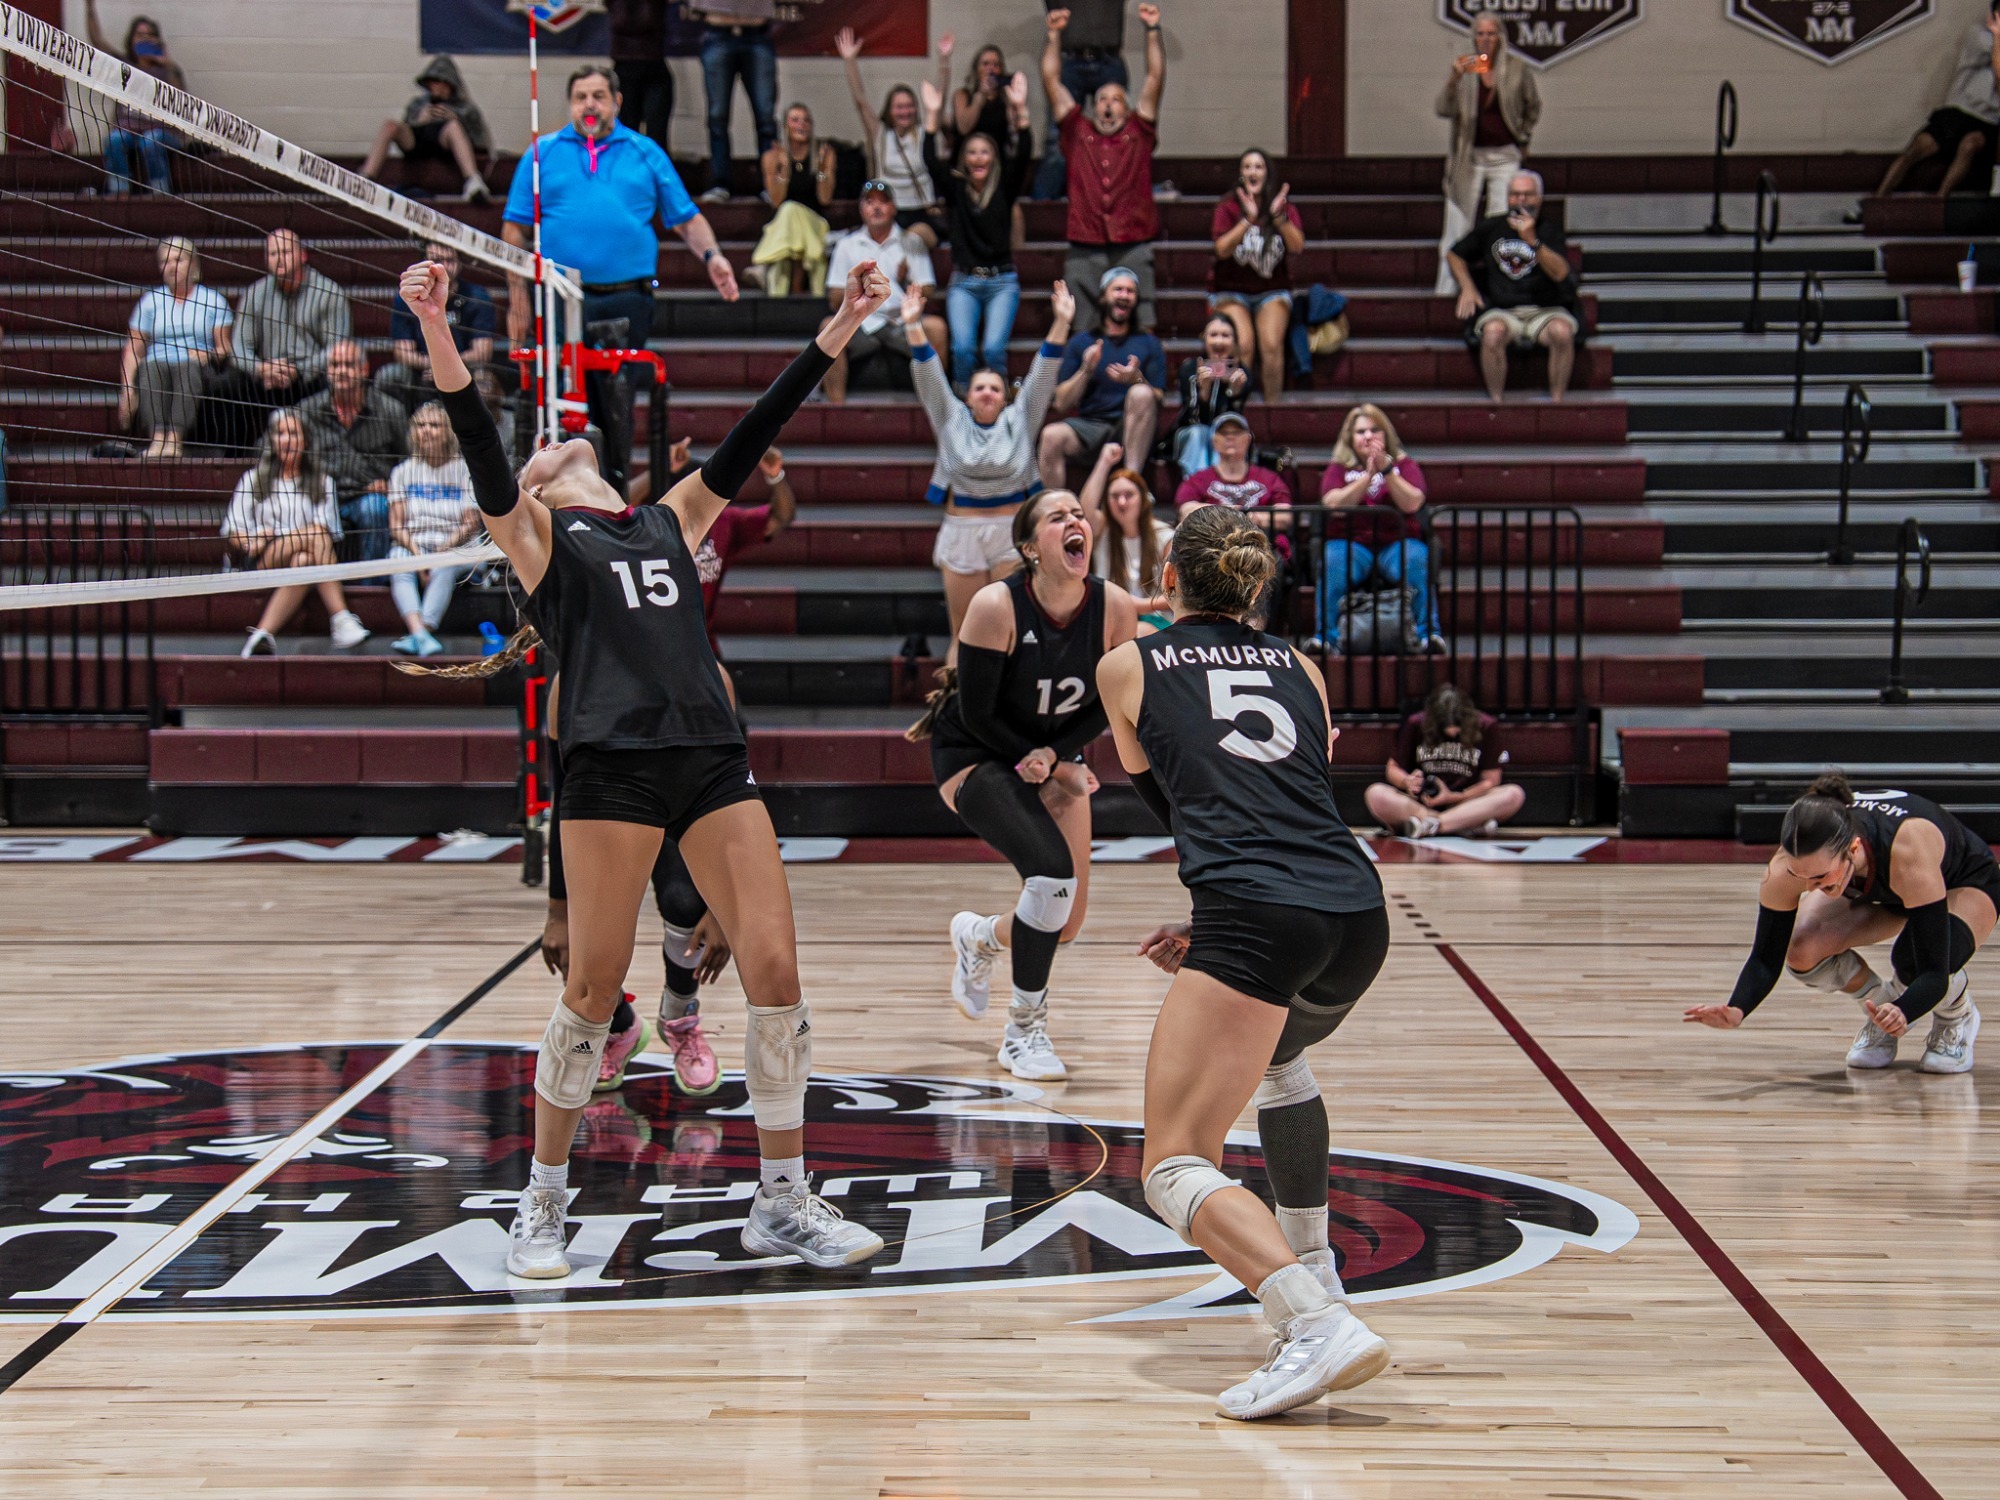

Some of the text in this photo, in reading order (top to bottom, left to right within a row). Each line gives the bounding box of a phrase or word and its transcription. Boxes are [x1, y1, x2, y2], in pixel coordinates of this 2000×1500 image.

[16, 10, 95, 77] UNIVERSITY
[152, 78, 261, 153] MCMURRY UNIVERSITY
[610, 558, 679, 609] 15
[1150, 645, 1292, 671] McMURRY
[1036, 676, 1085, 715] 12
[1206, 669, 1298, 763] 5
